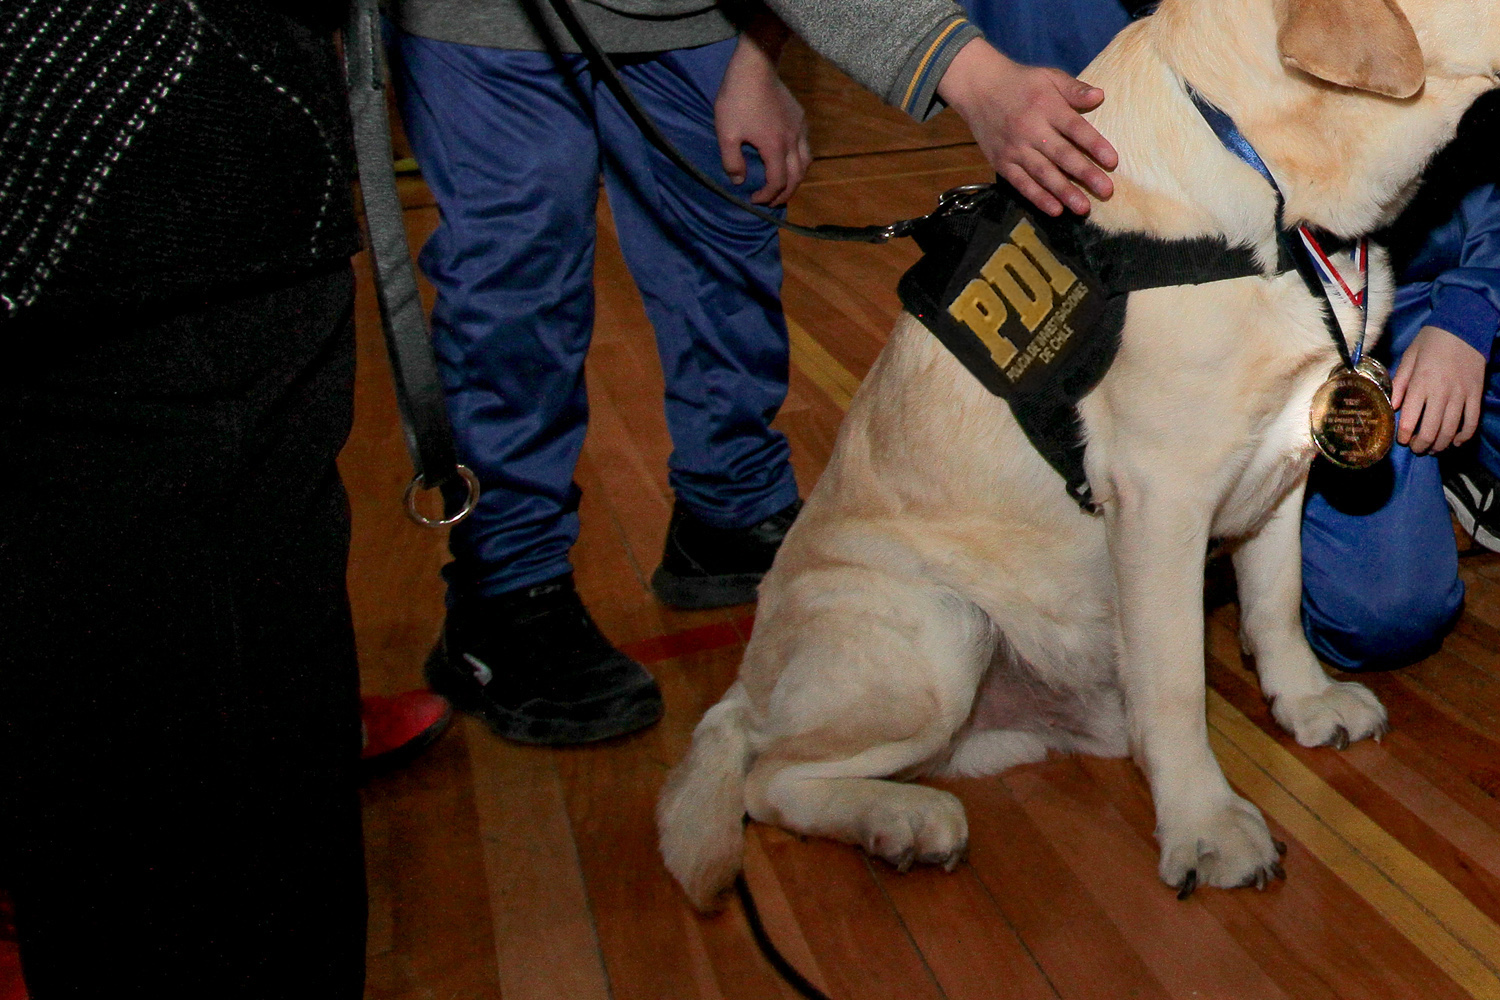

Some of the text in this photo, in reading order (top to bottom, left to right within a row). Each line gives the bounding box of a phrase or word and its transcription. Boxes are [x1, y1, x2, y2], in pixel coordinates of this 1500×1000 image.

[946, 217, 1078, 370] PDI
[1026, 341, 1041, 357] DE
[1039, 323, 1074, 364] DE CHILE
